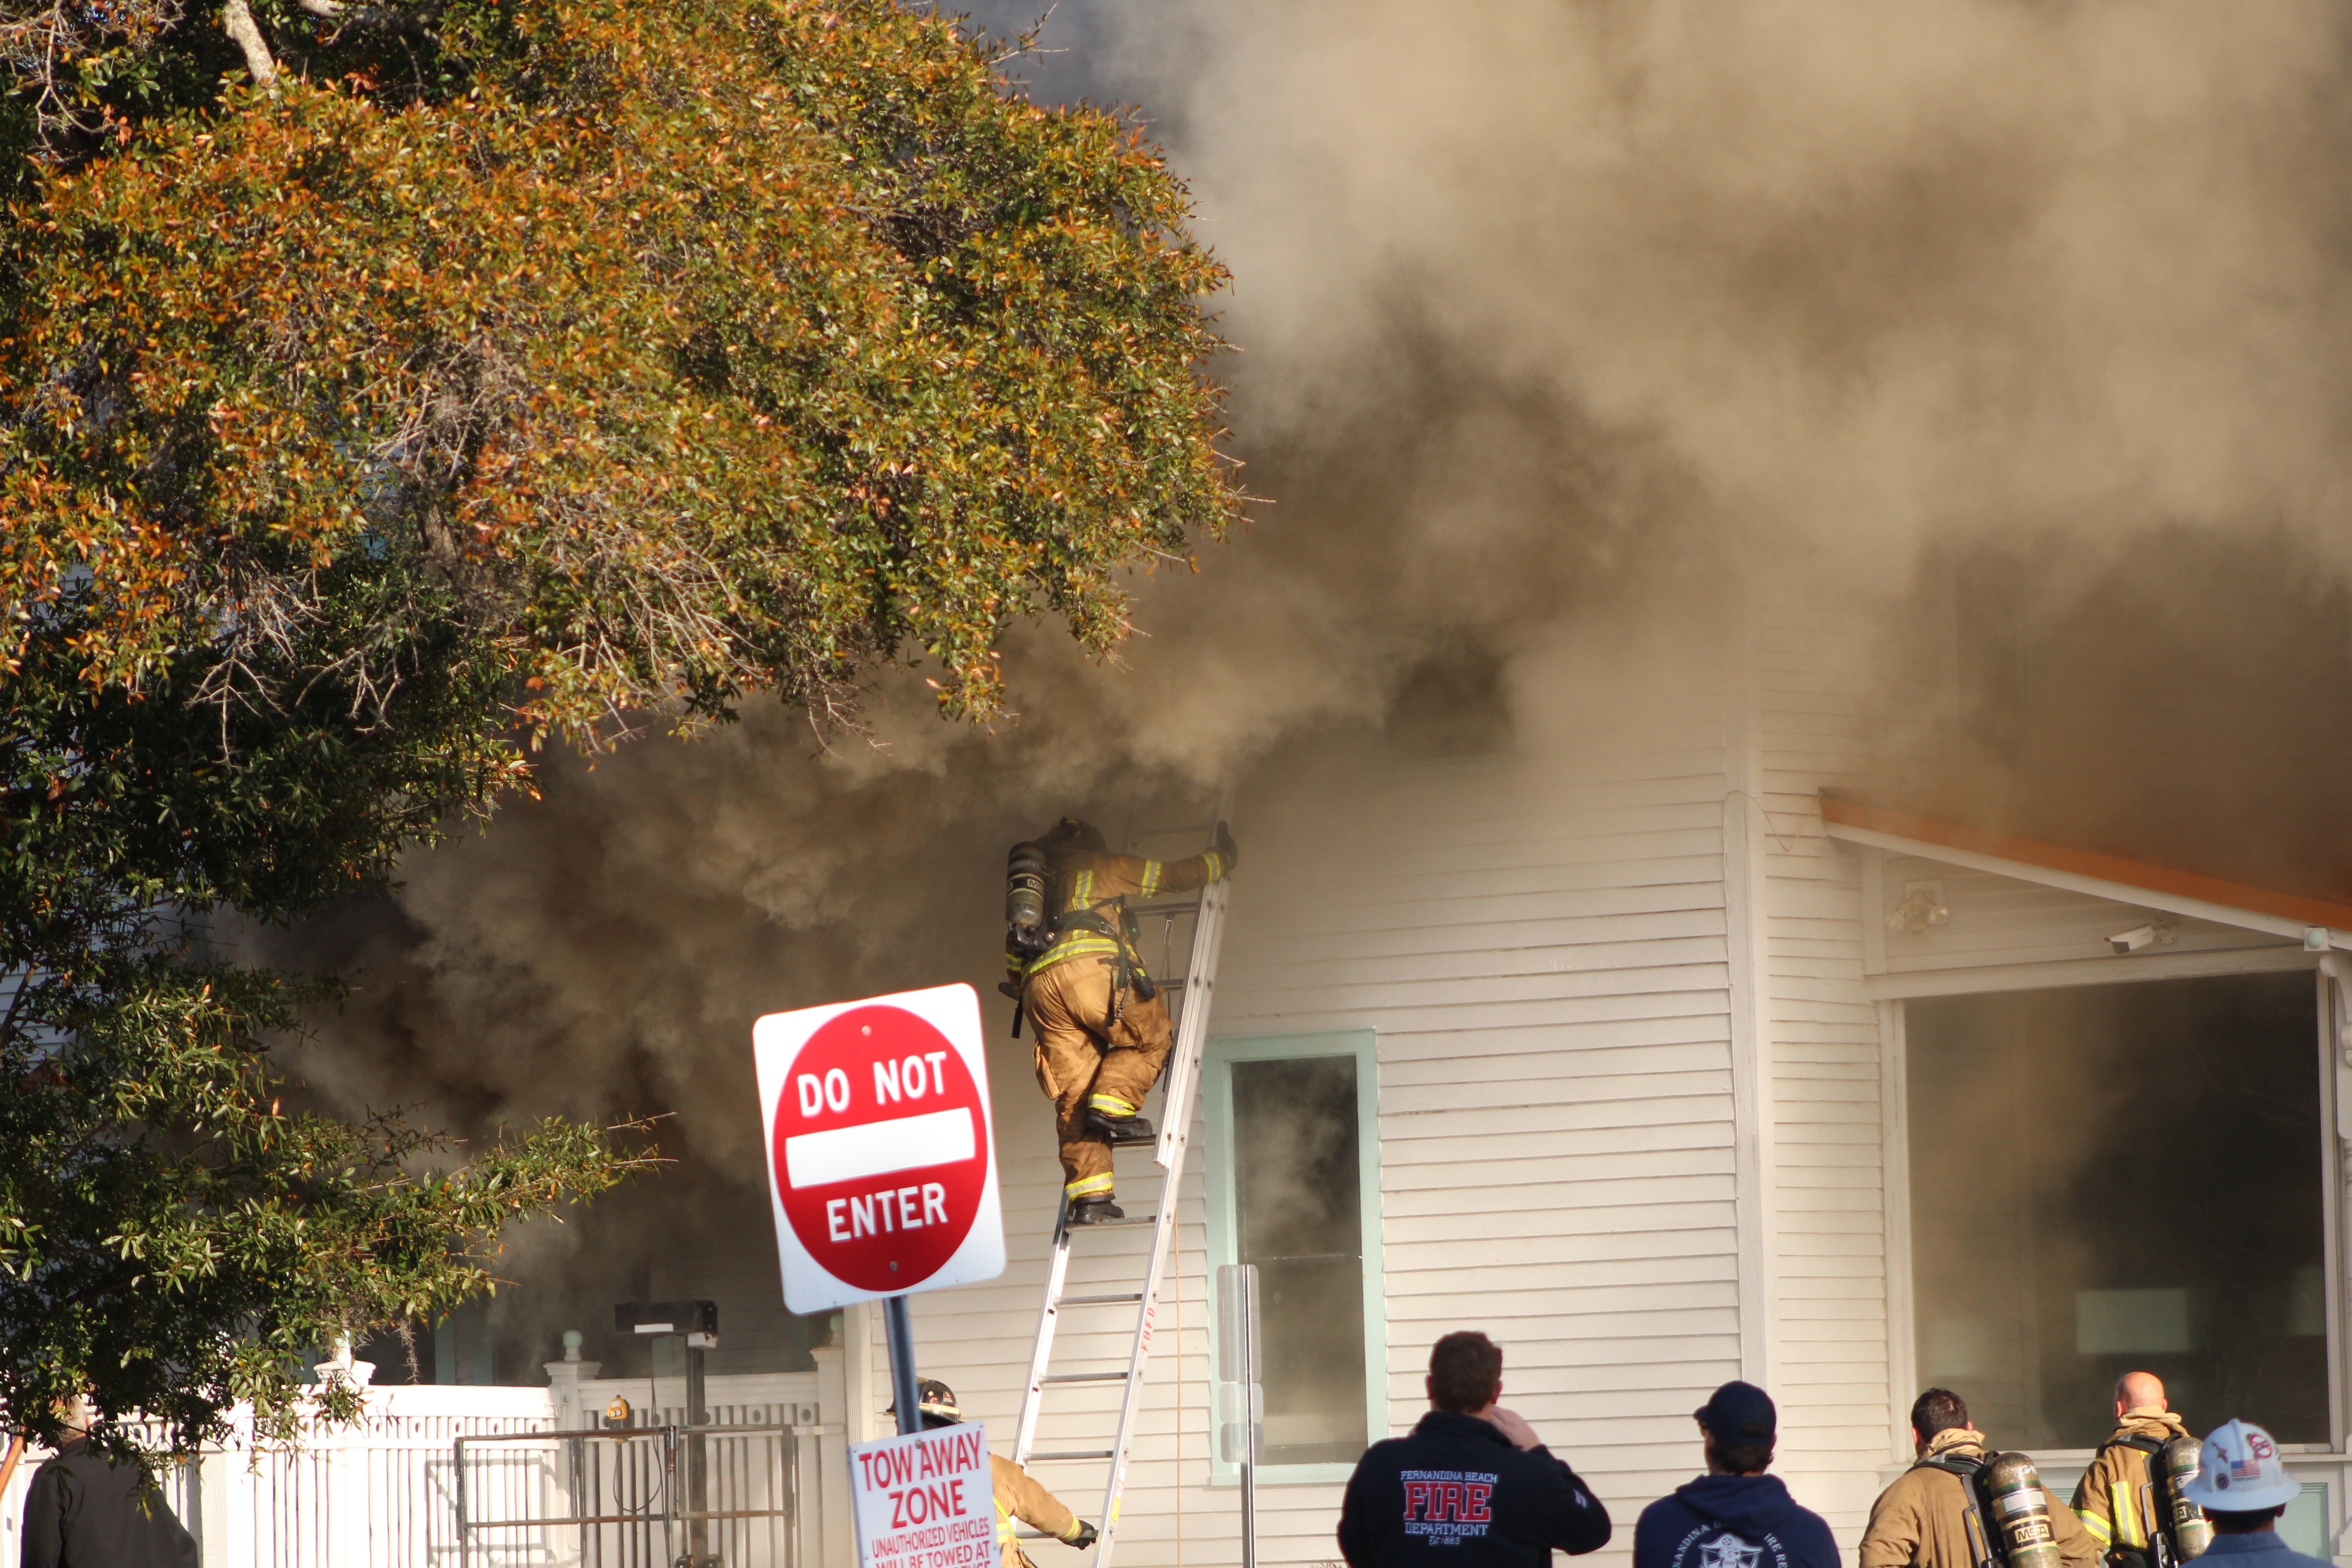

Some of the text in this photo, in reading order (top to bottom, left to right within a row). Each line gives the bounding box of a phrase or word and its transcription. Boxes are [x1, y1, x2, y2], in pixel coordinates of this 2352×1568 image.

[797, 1050, 947, 1118] DO NOT
[826, 1182, 948, 1242] ENTER
[858, 1430, 981, 1491] TOW AWAY
[1400, 1470, 1498, 1483] FERNANDINA BEACH
[888, 1478, 966, 1529] ZONE
[1403, 1481, 1492, 1522] FIRE
[871, 1516, 989, 1558] UNAUTHORIZED VEHICLES
[1405, 1522, 1488, 1536] DEPARTMENT
[1671, 1524, 1711, 1568] NANDINA
[2017, 1526, 2049, 1541] MSA
[926, 1543, 973, 1568] TOWED
[976, 1540, 990, 1560] AT
[1764, 1533, 1789, 1568] IRE RE
